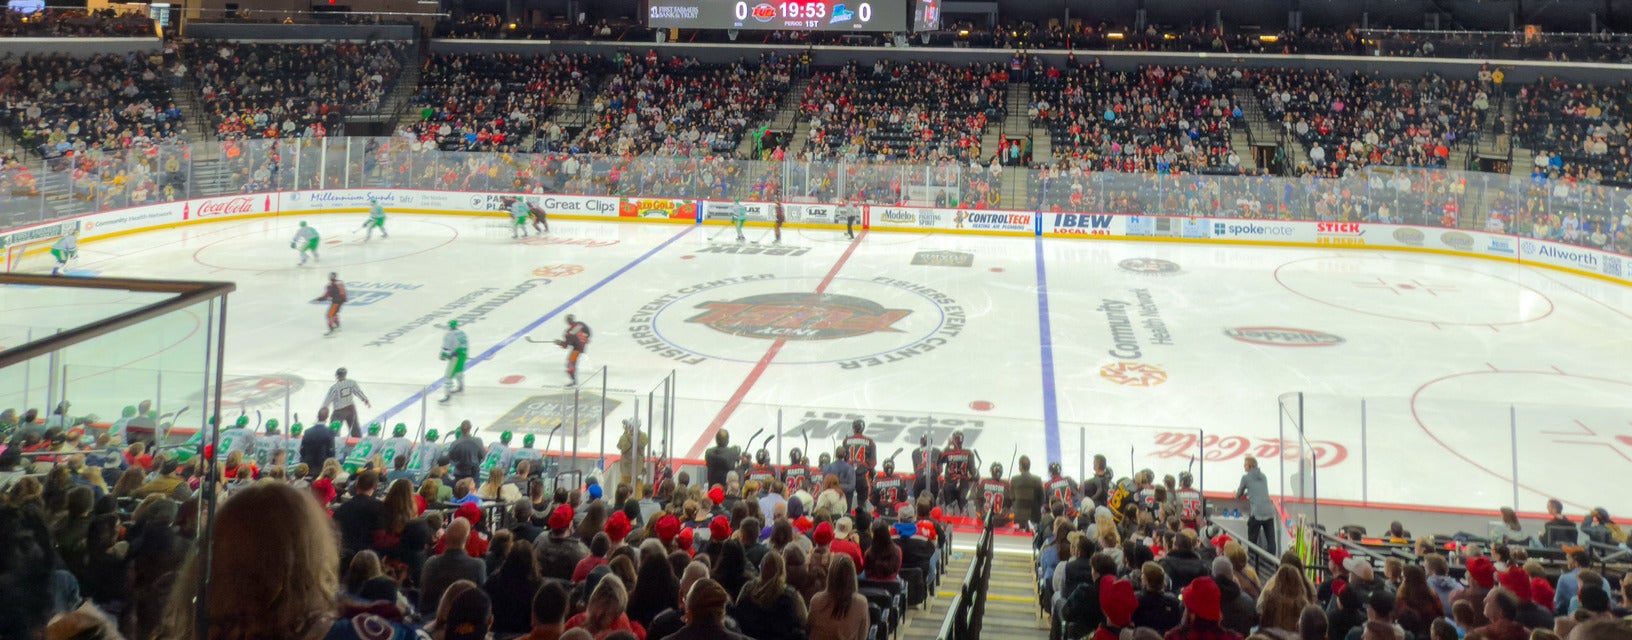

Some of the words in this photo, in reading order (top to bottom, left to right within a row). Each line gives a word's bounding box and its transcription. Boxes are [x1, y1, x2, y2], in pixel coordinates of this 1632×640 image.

[735, 1, 748, 20] 0
[779, 2, 826, 18] 19:53
[859, 2, 872, 22] 0
[310, 192, 365, 202] Millennium
[366, 191, 395, 202] Sounds
[544, 197, 580, 210] Great
[585, 199, 615, 214] Clips
[636, 200, 652, 210] RED
[653, 199, 675, 211] GOLD
[885, 209, 912, 220] Modelo
[968, 212, 1031, 225] CONTROLTECH
[1053, 213, 1114, 229] IBEW
[1228, 223, 1293, 236] spokenote
[1317, 222, 1360, 233] STICK
[1538, 244, 1598, 265] Allworth
[677, 273, 776, 294] CENTER
[1096, 298, 1143, 359] Community
[1141, 318, 1175, 346] Health
[628, 325, 707, 365] FISHERS
[837, 337, 948, 370] CENTER
[848, 446, 866, 462] 14
